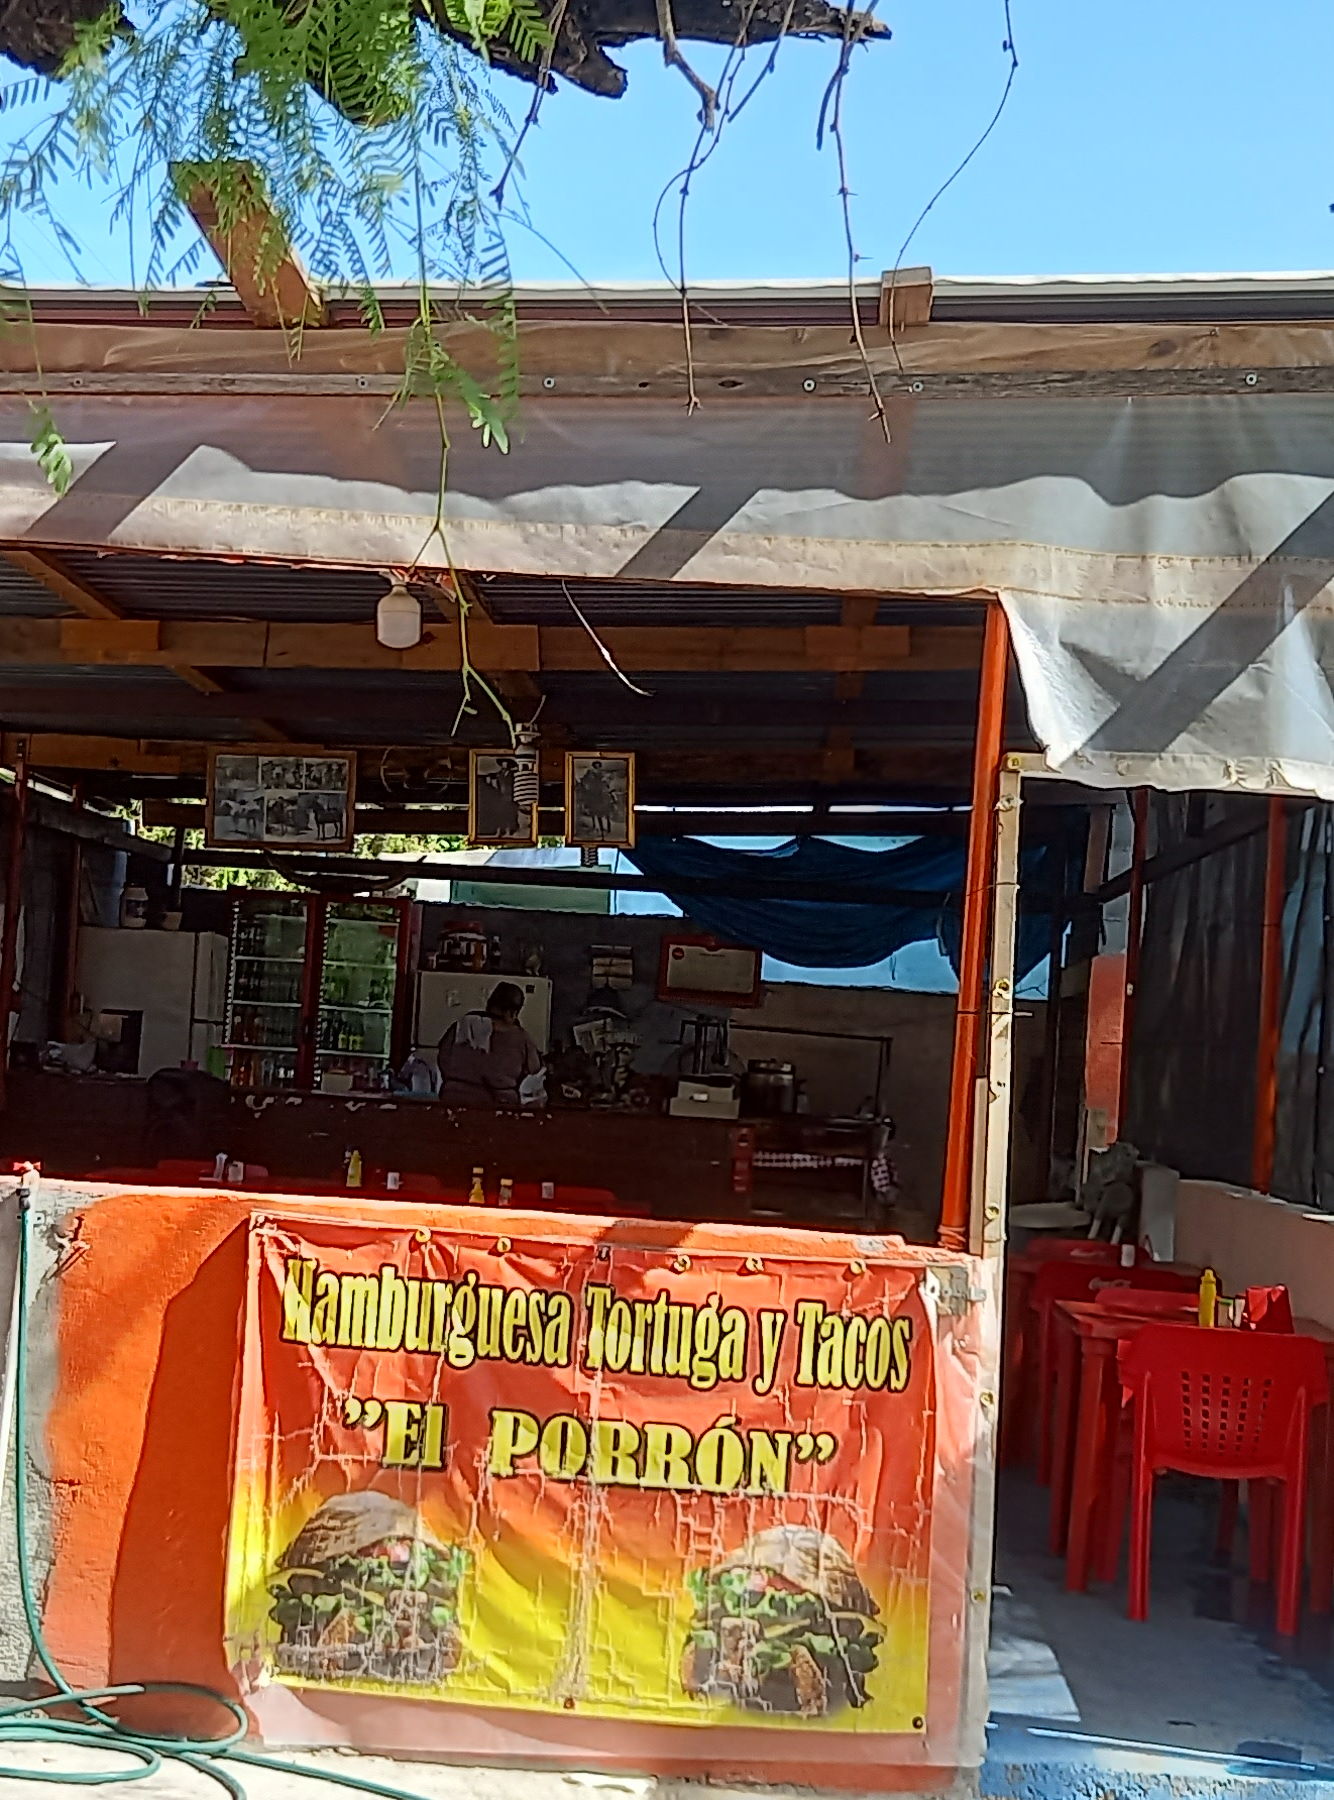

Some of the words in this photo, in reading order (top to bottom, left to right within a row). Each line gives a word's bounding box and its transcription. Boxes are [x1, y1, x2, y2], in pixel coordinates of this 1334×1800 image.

[281, 1257, 575, 1368] Hamburguesa
[585, 1284, 746, 1390] Tortuga
[753, 1309, 786, 1395] y
[795, 1300, 912, 1392] Tacos
